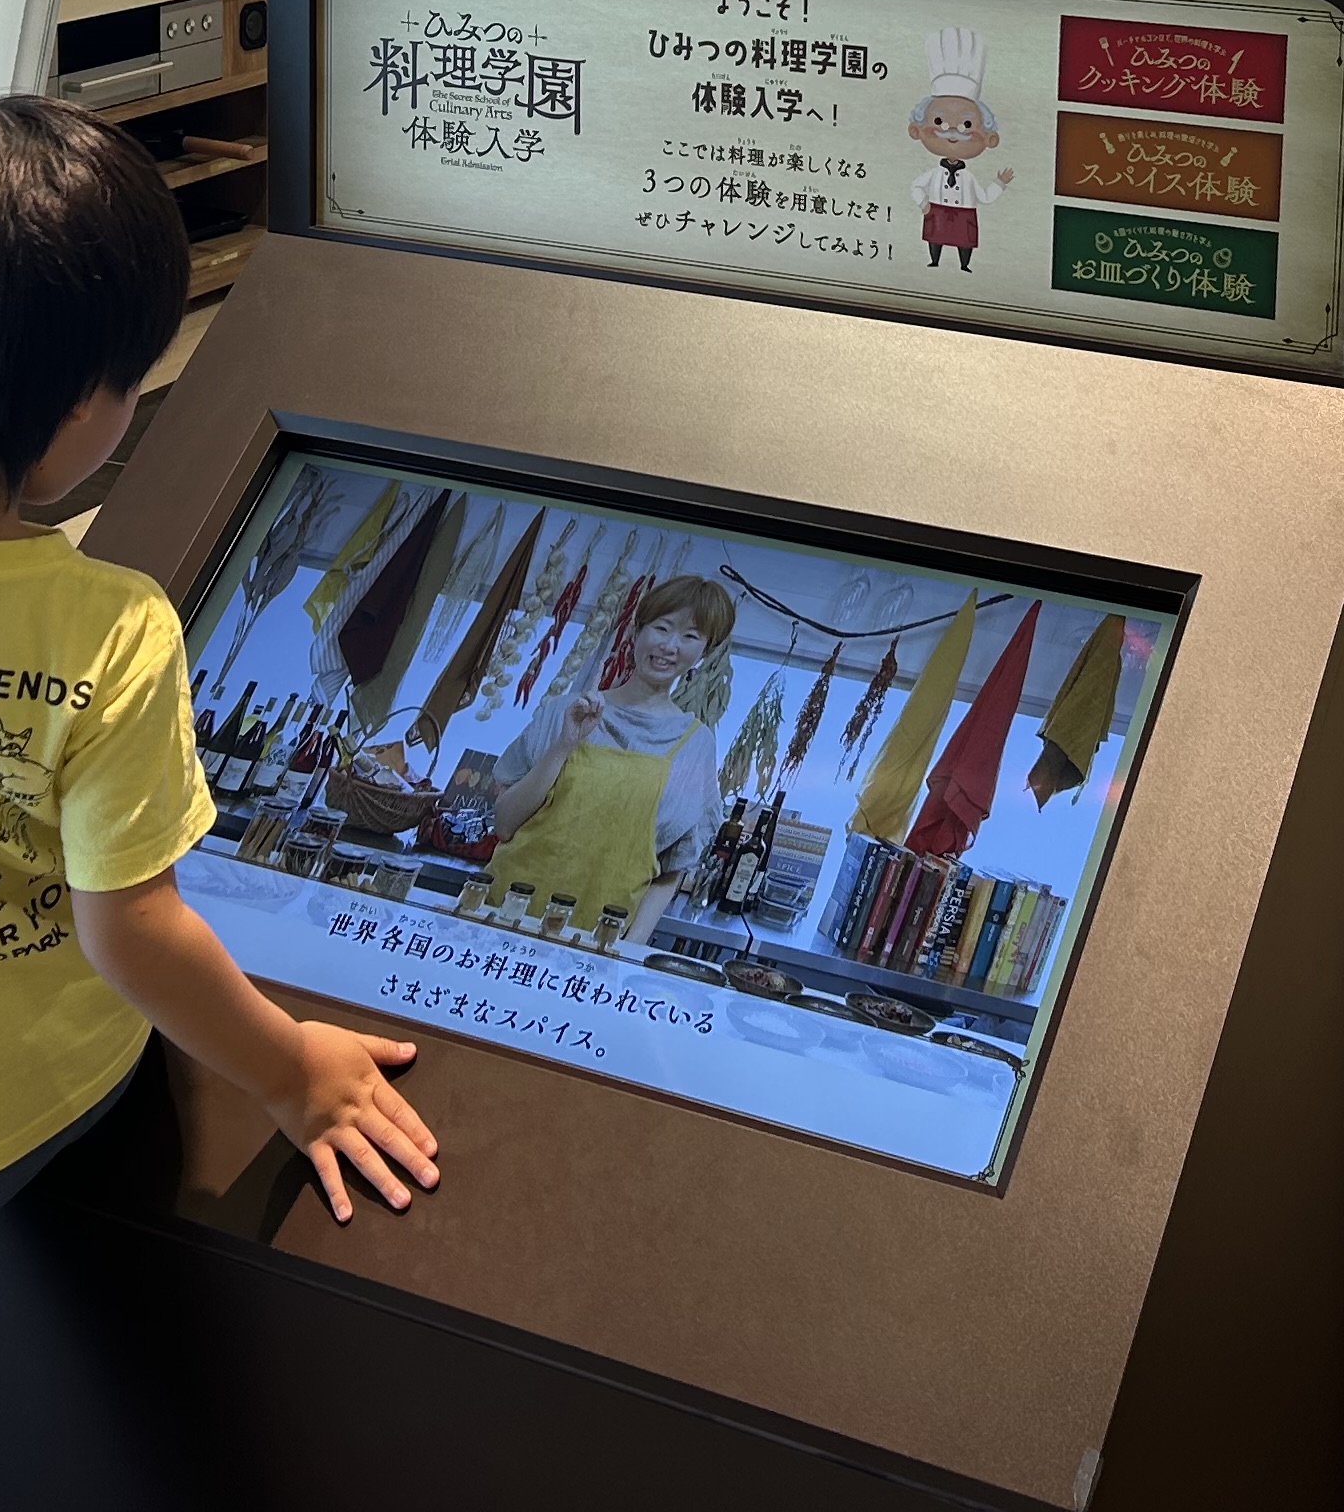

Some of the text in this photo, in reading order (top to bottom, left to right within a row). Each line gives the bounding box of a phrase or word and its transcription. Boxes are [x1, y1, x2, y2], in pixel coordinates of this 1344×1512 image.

[424, 9, 524, 45] ひみつの
[648, 29, 889, 81] ひみつの料理学園の
[1130, 45, 1212, 71] ひみつの
[362, 37, 587, 136] 料理学園
[691, 80, 839, 127] 体験入学へ！
[1077, 65, 1267, 109] クッキング体験
[429, 99, 513, 121] Culinary Arts
[402, 116, 546, 162] 体験入学
[661, 140, 868, 180] ここでは料理が楽しくなる
[1126, 142, 1208, 170] ひみつの
[1075, 162, 1262, 208] スパイス体験
[634, 210, 894, 261] ぜひチャレンジしてみよう！
[1122, 237, 1205, 267] ひみつの
[1071, 258, 1256, 306] お皿づくり体験
[22, 882, 71, 931] HO
[938, 887, 965, 936] PERSIA
[11, 922, 69, 959] PARK
[328, 912, 714, 1035] 世界各国のお料理に使われている
[379, 974, 607, 1059] さまざまなスパイス。
